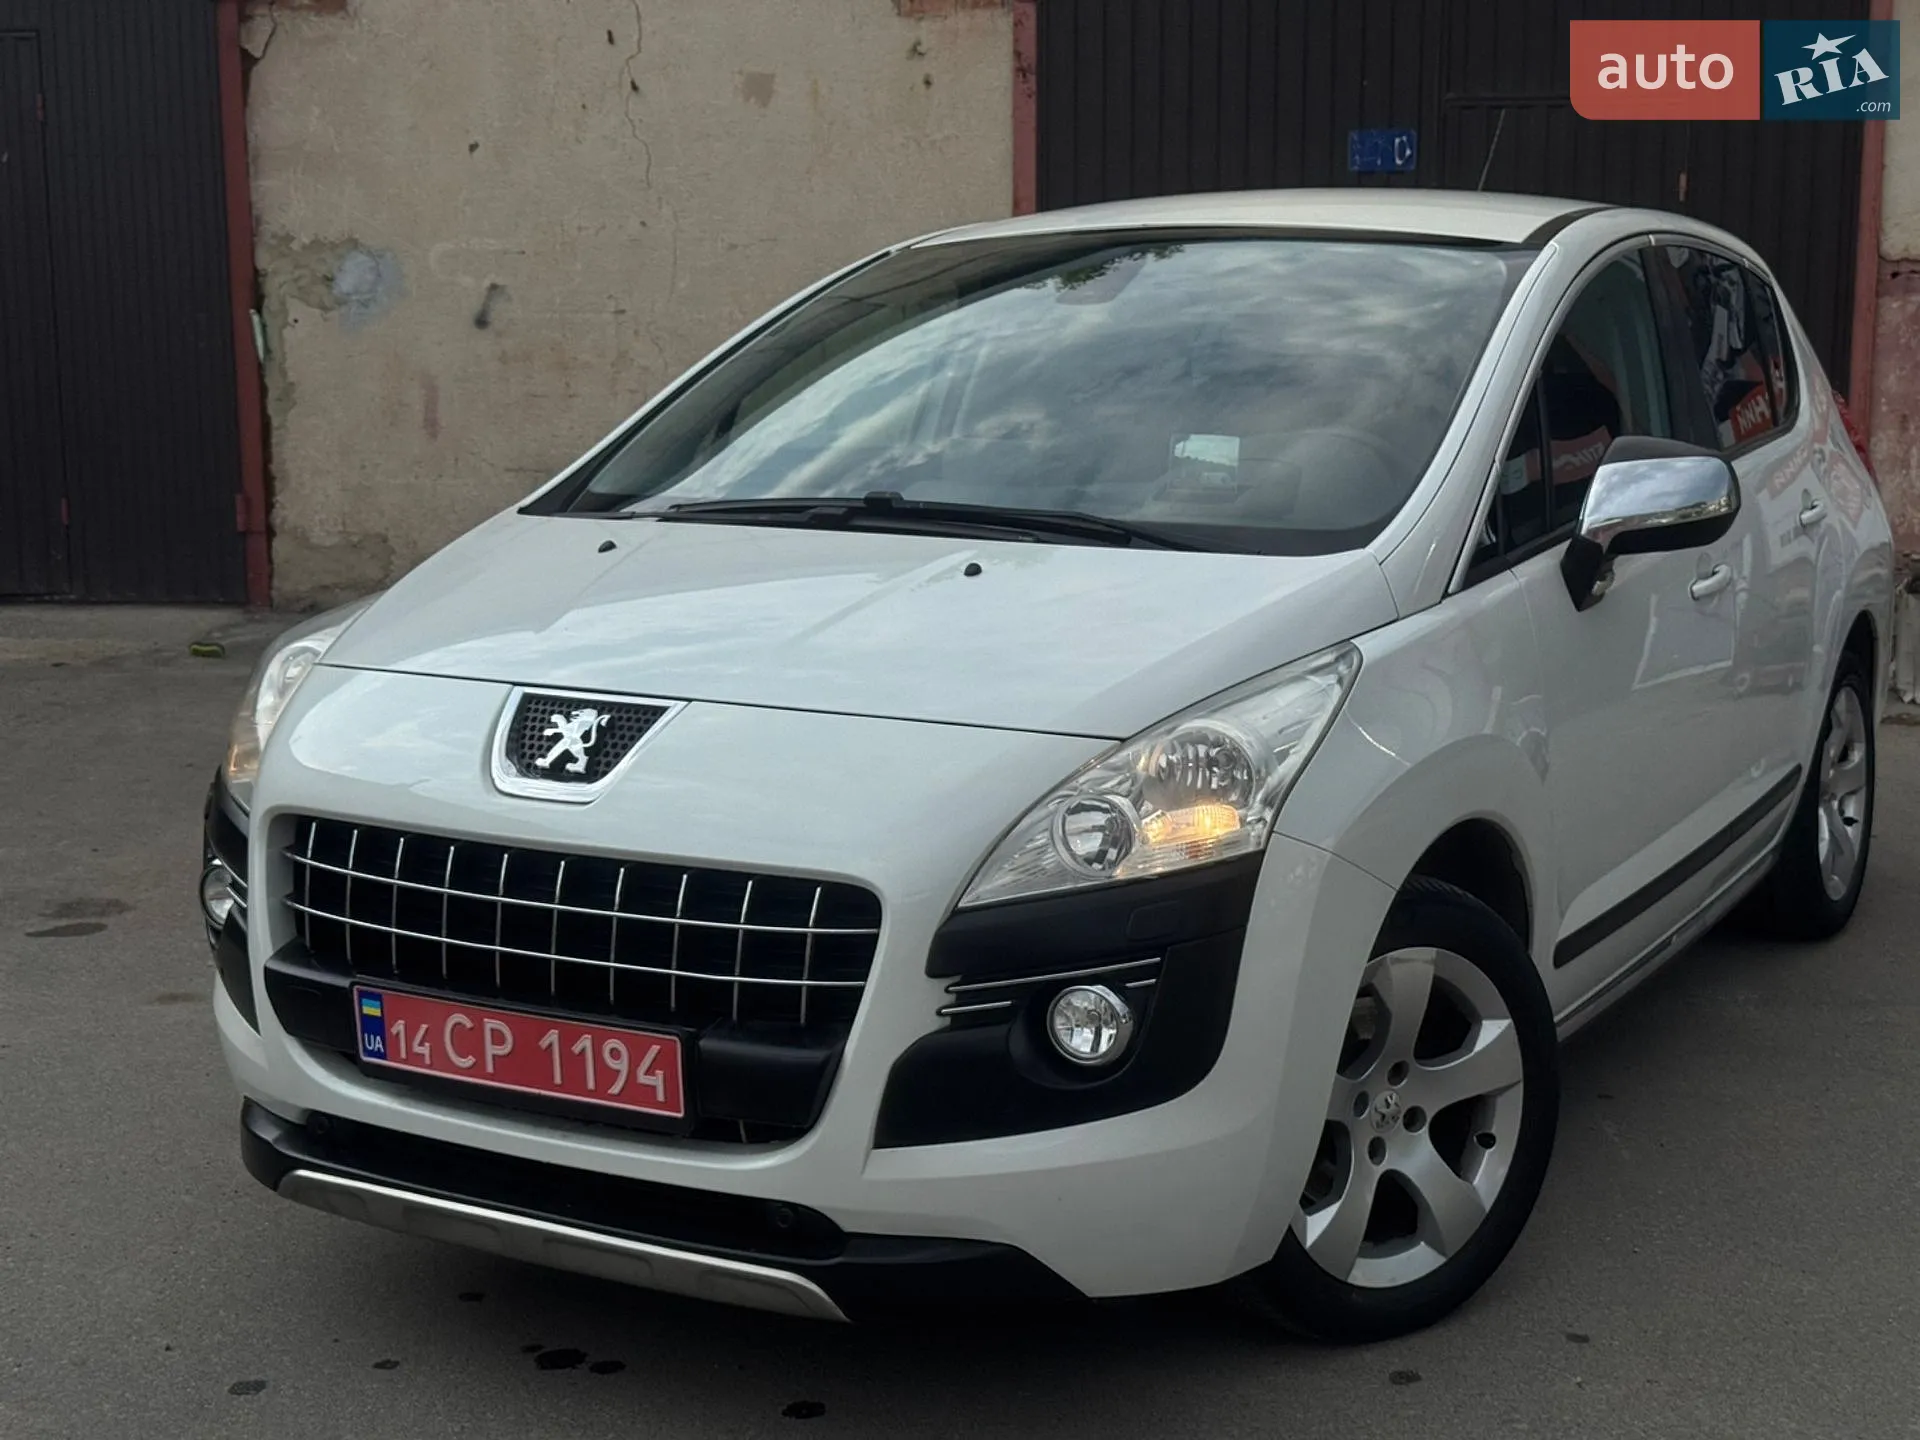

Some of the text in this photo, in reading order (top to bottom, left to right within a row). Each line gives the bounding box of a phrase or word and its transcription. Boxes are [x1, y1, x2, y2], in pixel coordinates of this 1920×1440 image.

[364, 1034, 385, 1053] UA
[390, 1013, 666, 1103] 14 CP 1194
